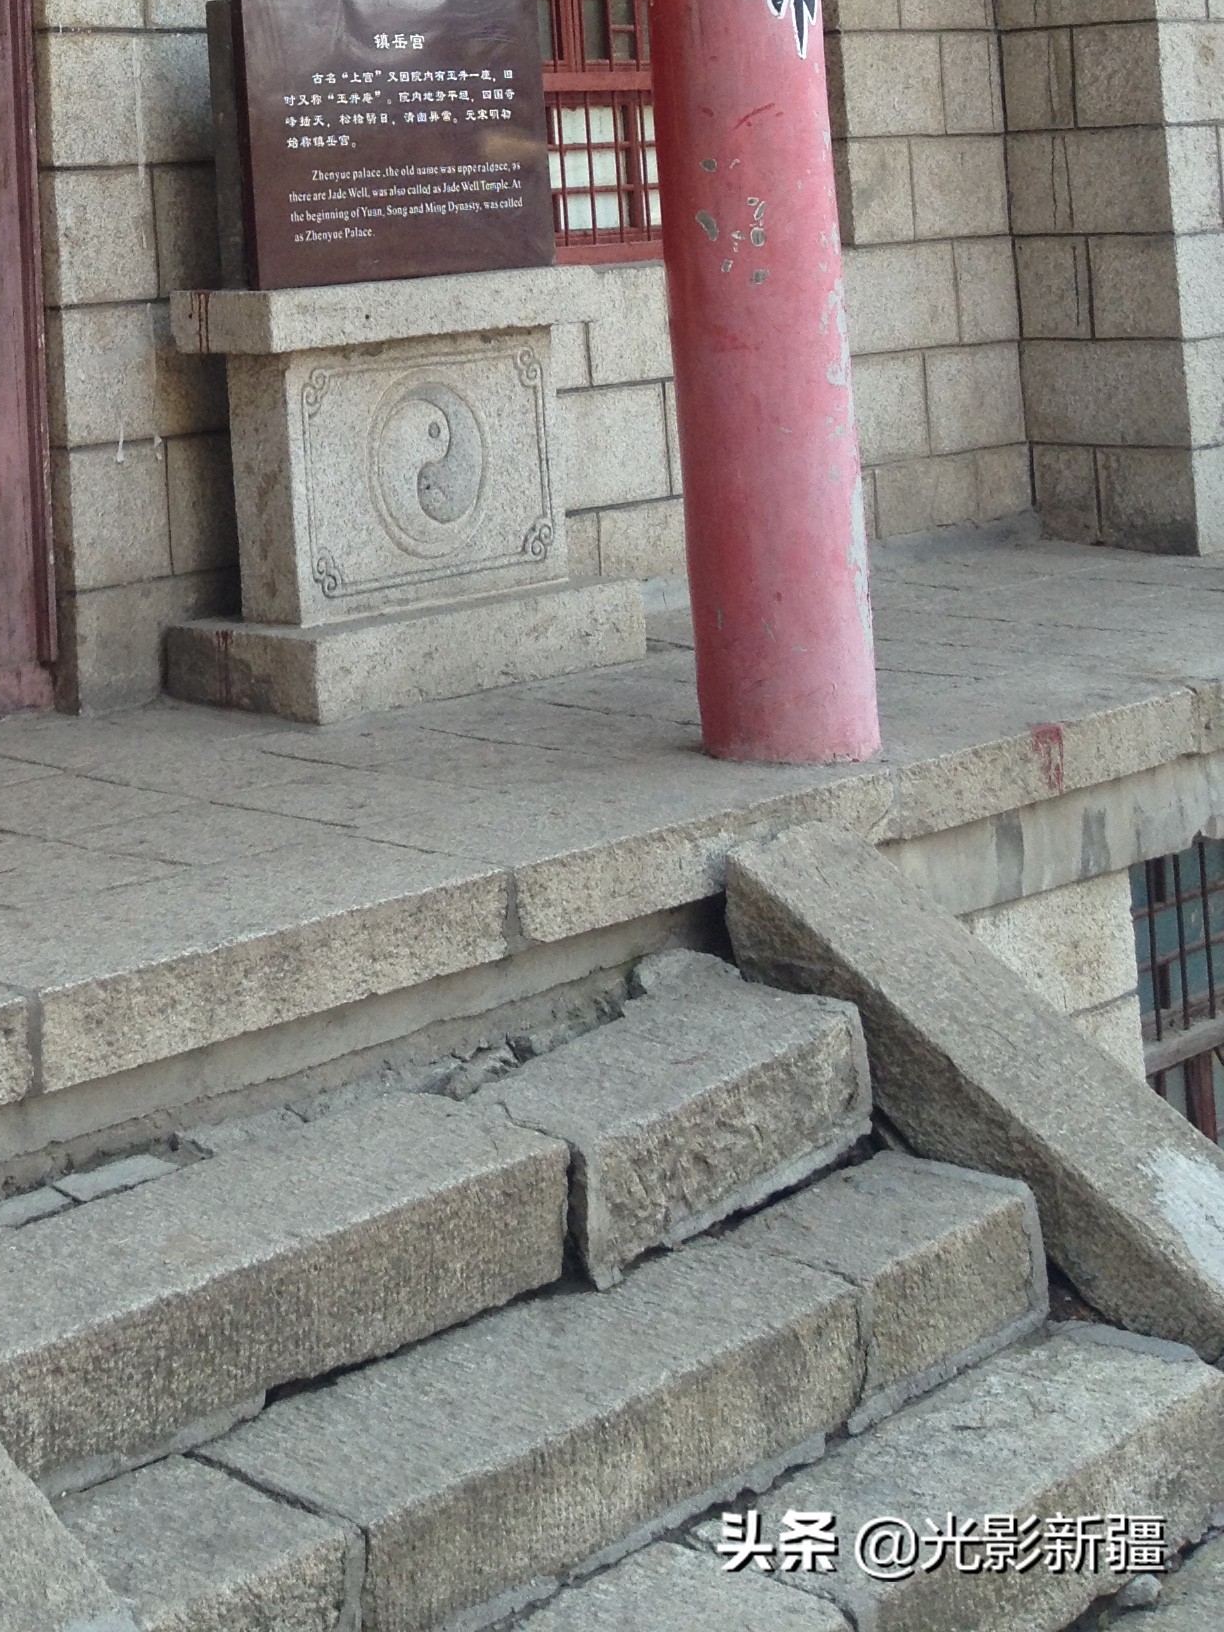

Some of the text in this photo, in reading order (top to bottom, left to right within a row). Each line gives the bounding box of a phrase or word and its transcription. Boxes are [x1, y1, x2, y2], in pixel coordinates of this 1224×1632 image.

[374, 33, 426, 50] 镇岳宫
[312, 170, 351, 182] Zhenyue
[353, 167, 381, 181] palace
[401, 165, 415, 176] old
[417, 166, 438, 175] name
[440, 166, 456, 174] was
[512, 162, 521, 170] as
[289, 191, 311, 202] there
[313, 192, 327, 201] are
[328, 188, 347, 200] Jade
[372, 189, 388, 197] was
[389, 185, 406, 195] also
[407, 184, 431, 195] called
[433, 185, 442, 194] as
[443, 182, 460, 193] Jade
[461, 181, 479, 192] Well
[511, 179, 522, 189] At
[291, 211, 305, 222] the
[306, 209, 350, 223] beginning
[351, 207, 361, 218] of
[386, 205, 408, 218] Song
[409, 203, 424, 214] and
[425, 201, 447, 215] Ming
[484, 201, 499, 209] was
[499, 197, 523, 208] called
[295, 233, 304, 242] as
[305, 229, 343, 242] Zhenyue
